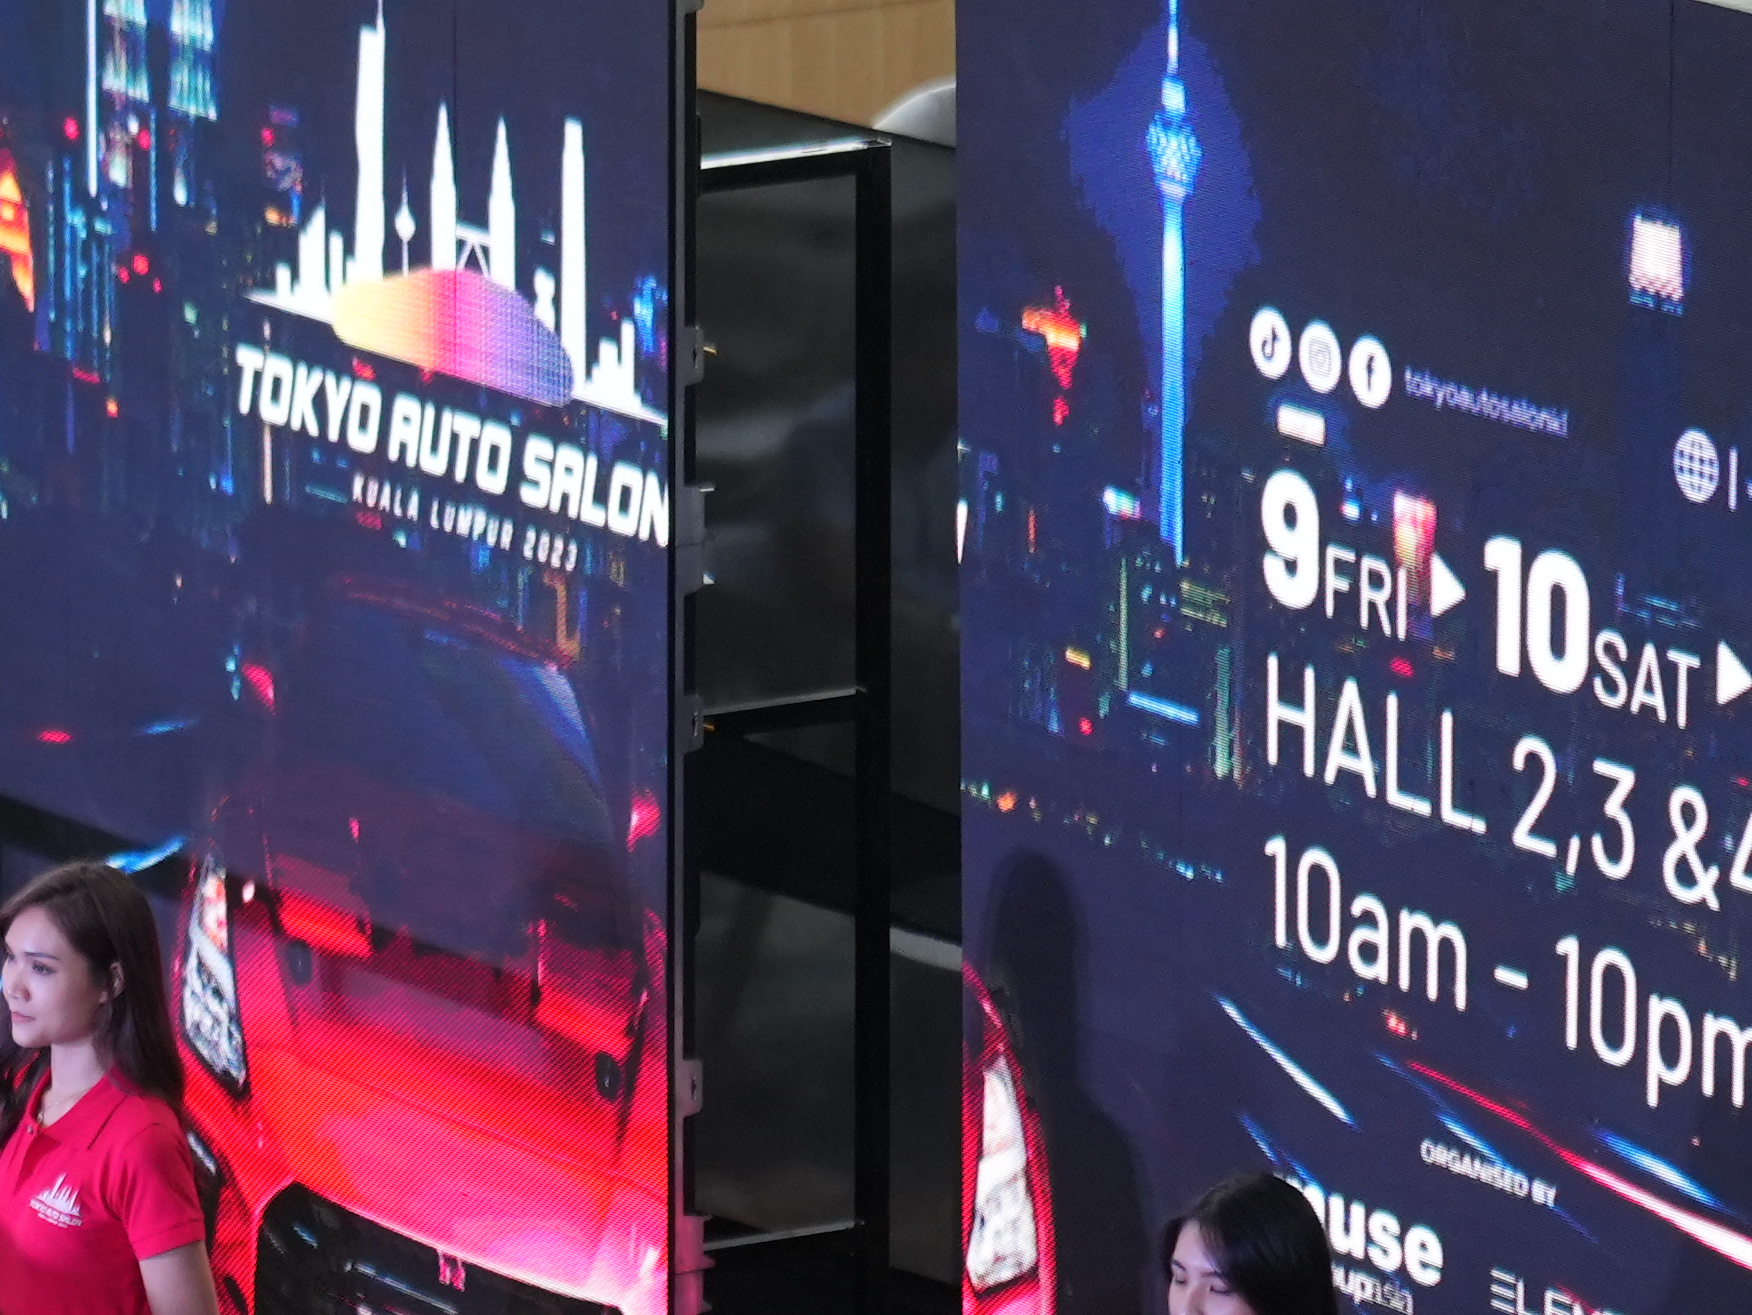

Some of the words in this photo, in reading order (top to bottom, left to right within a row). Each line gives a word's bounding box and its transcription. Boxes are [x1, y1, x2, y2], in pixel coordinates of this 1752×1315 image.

[236, 343, 382, 455] TOKYO
[388, 393, 510, 497] AUTO
[518, 440, 669, 548] SALON
[352, 472, 420, 523] KUALA
[430, 494, 514, 552] LUMPUR
[523, 523, 579, 573] 2023
[1266, 652, 1488, 835] HALL
[1264, 834, 1469, 1014] 10am
[1554, 933, 1752, 1109] 10pm
